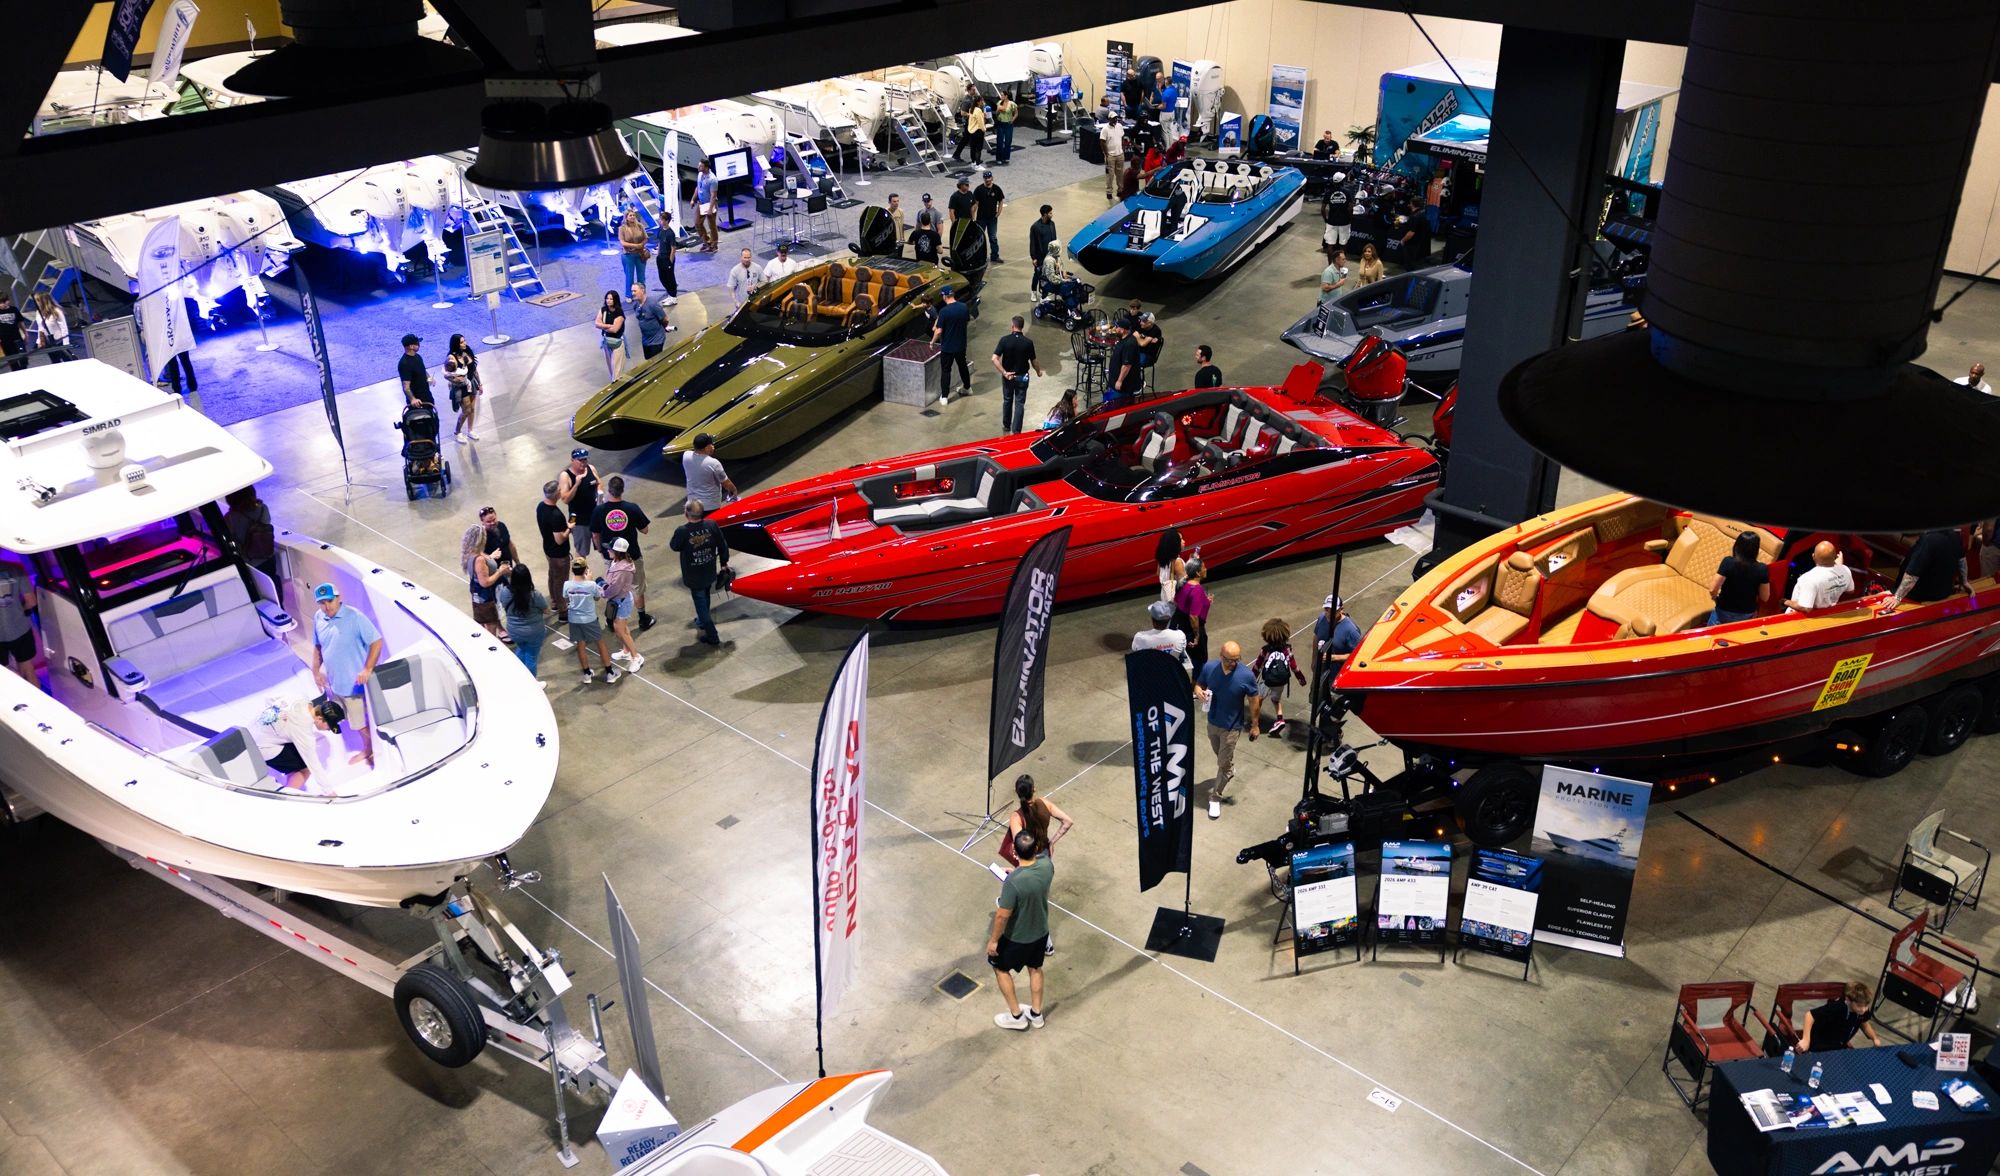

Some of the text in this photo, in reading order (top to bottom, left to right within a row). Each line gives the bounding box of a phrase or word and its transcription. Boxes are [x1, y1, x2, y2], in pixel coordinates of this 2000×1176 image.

[1430, 145, 1487, 160] ELIMINATO
[160, 263, 174, 348] GRADY-WITE
[82, 418, 122, 436] SIMRAD
[1832, 667, 1862, 683] BOAT
[1827, 679, 1855, 693] SHOW
[1147, 705, 1165, 829] OF THE WEST
[1164, 701, 1188, 819] AMP
[1136, 713, 1149, 838] PERFORMANCE BOATS
[1556, 781, 1634, 807] MARINE
[1555, 795, 1633, 813] PROTECTION FILM
[1580, 897, 1616, 909] SELF-HEALING
[1567, 906, 1615, 920] SUPERIOR CLARITY
[1547, 924, 1561, 932] EDGE
[1576, 929, 1610, 941] TECHNOLOGY
[1576, 919, 1603, 929] FLAWLESS
[627, 1137, 656, 1155] READY
[1810, 1137, 1965, 1176] AMP
[1894, 1164, 1953, 1176] WEST
